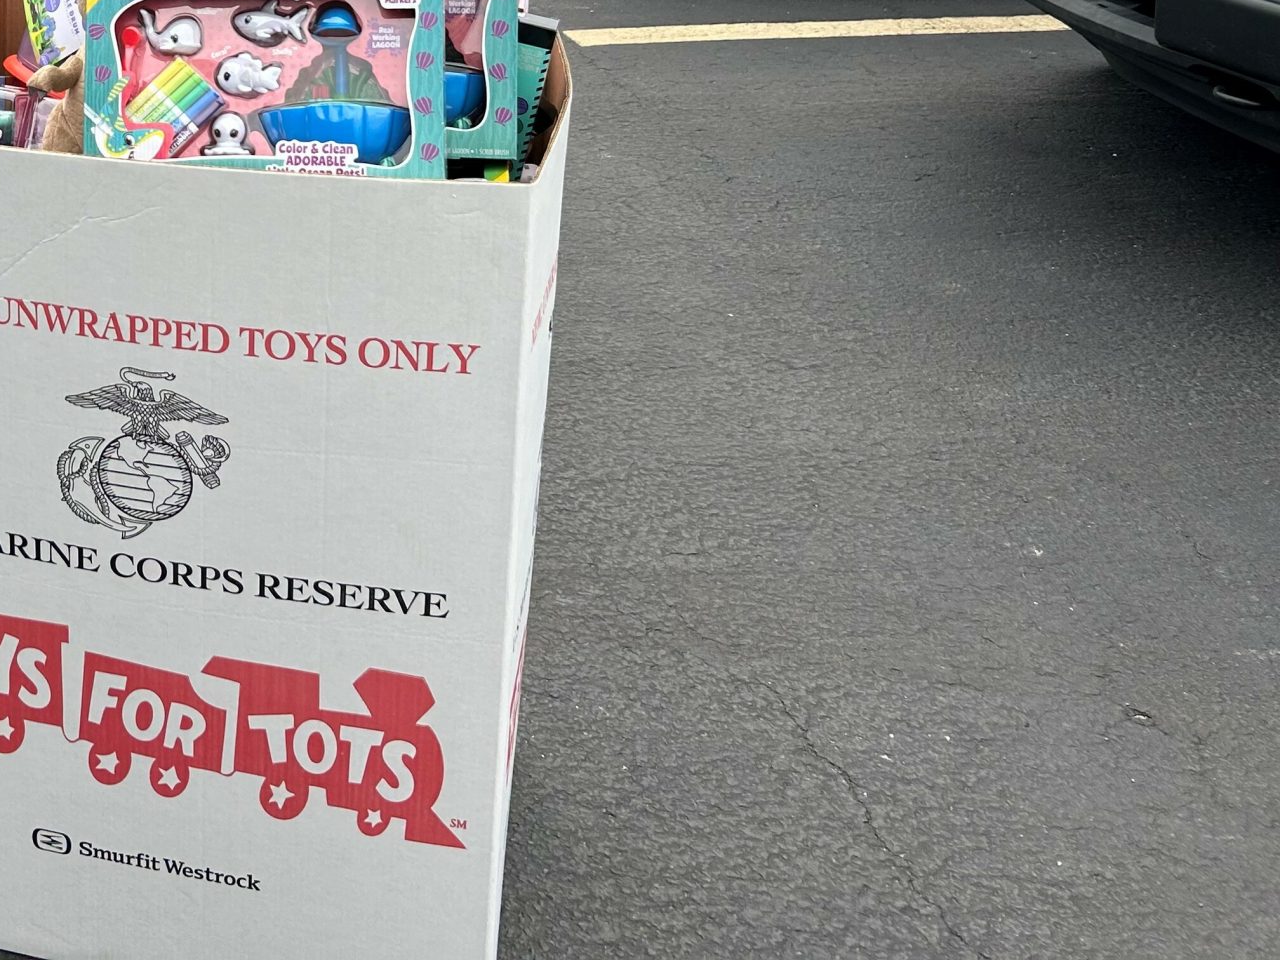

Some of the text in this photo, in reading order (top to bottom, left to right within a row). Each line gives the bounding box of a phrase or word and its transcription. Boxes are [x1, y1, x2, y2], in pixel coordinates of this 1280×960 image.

[69, 10, 80, 35] DRUM
[372, 35, 401, 43] Working
[279, 143, 354, 154] Color & Clean
[286, 155, 346, 166] ADORABLE
[239, 326, 348, 366] TOYS
[358, 337, 481, 375] ONLY
[109, 552, 244, 595] CORPS
[254, 572, 450, 619] RESERVE
[87, 670, 207, 758] FOR
[247, 713, 417, 803] TOTS
[449, 818, 468, 830] SM
[79, 841, 261, 891] Smurfit Westrock
